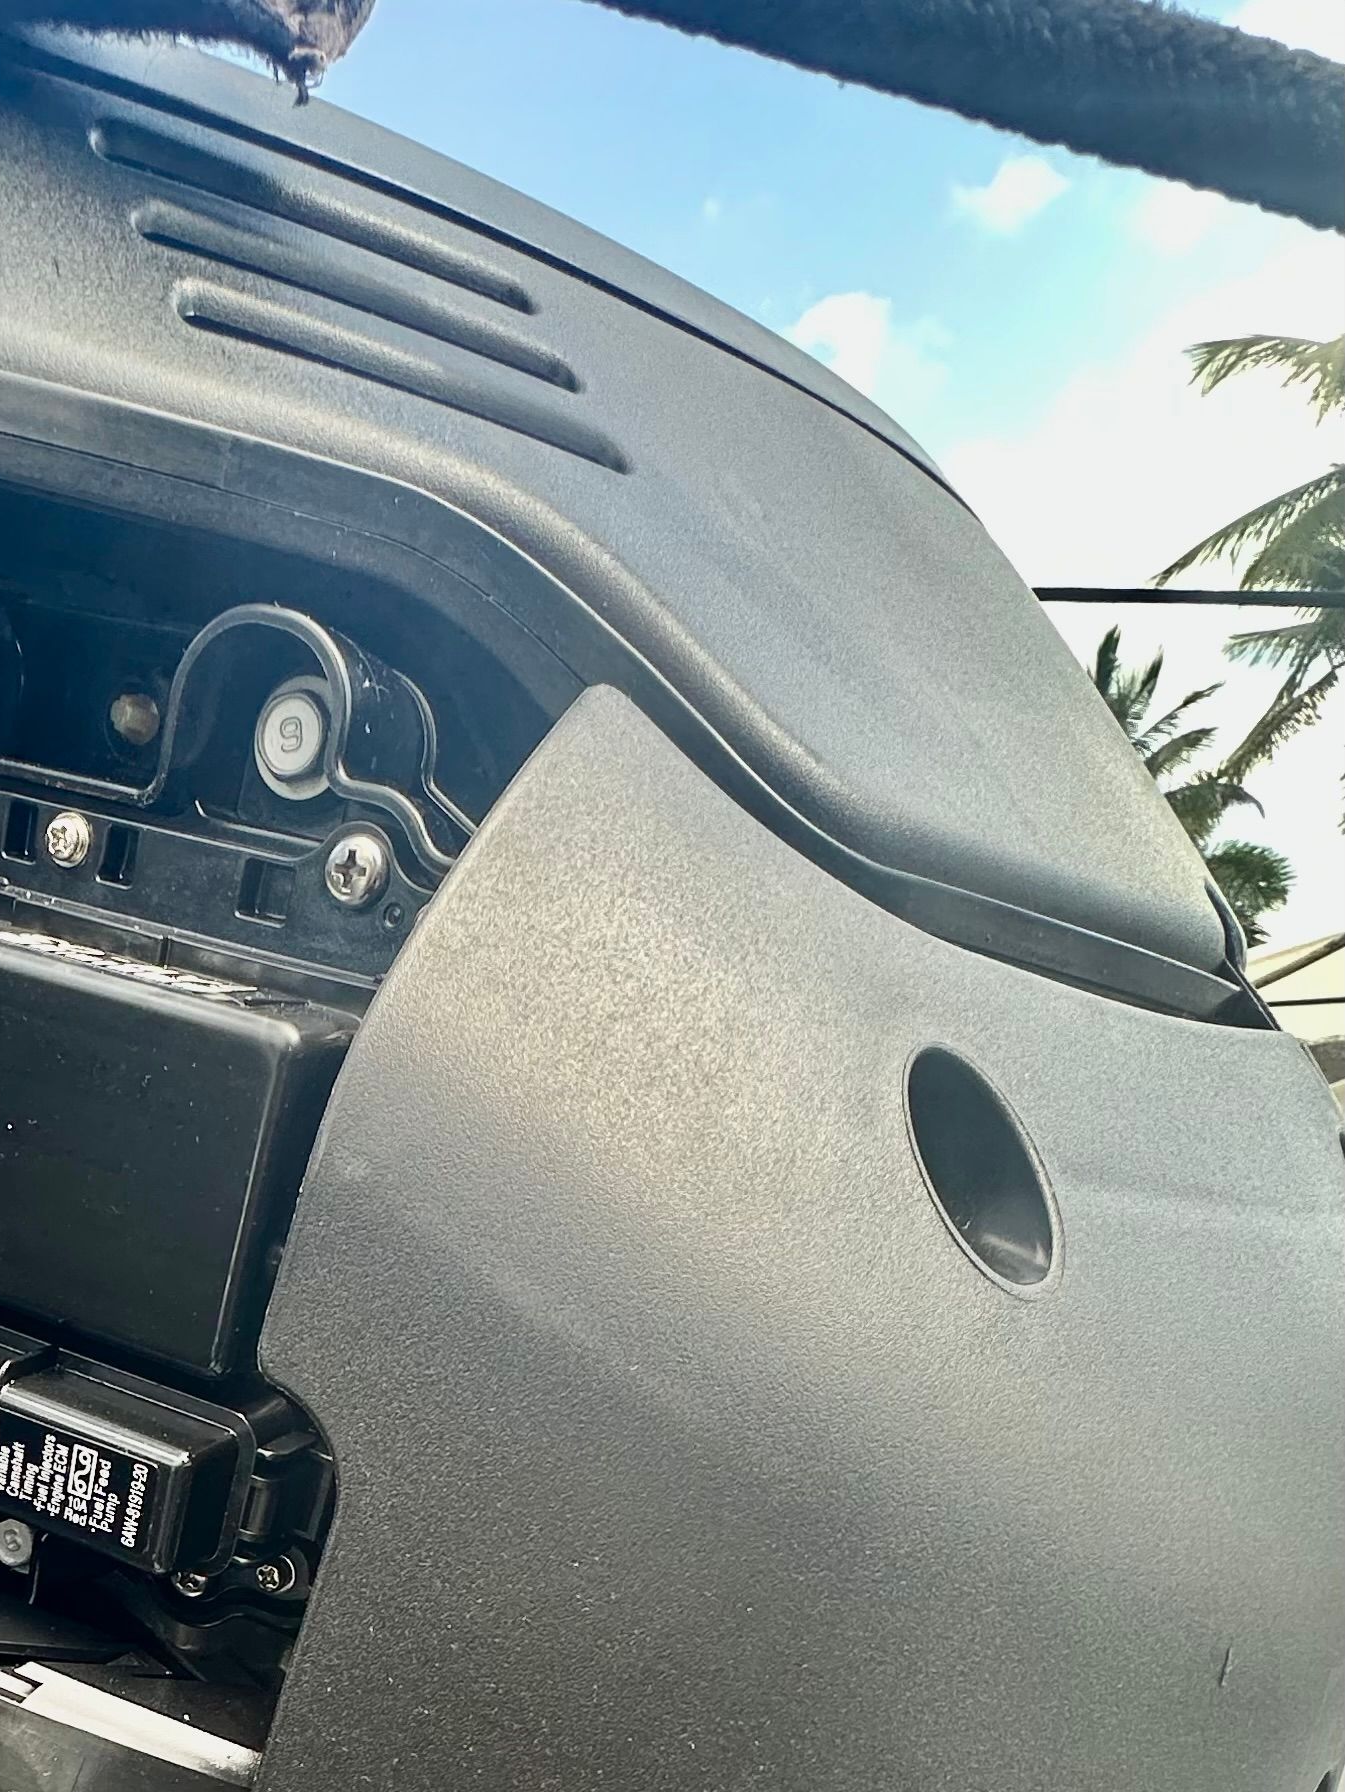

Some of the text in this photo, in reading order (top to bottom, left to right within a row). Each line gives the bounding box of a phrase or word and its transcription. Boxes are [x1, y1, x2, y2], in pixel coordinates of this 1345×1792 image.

[6, 1441, 25, 1497] Camshaft
[39, 1434, 56, 1482] Injectors
[47, 1444, 69, 1514] Engine ECM
[19, 1463, 39, 1501] Timing
[89, 1459, 111, 1528] Fuel Feed
[63, 1507, 87, 1527] Red
[68, 1496, 87, 1513] 10A
[100, 1493, 120, 1532] Pump
